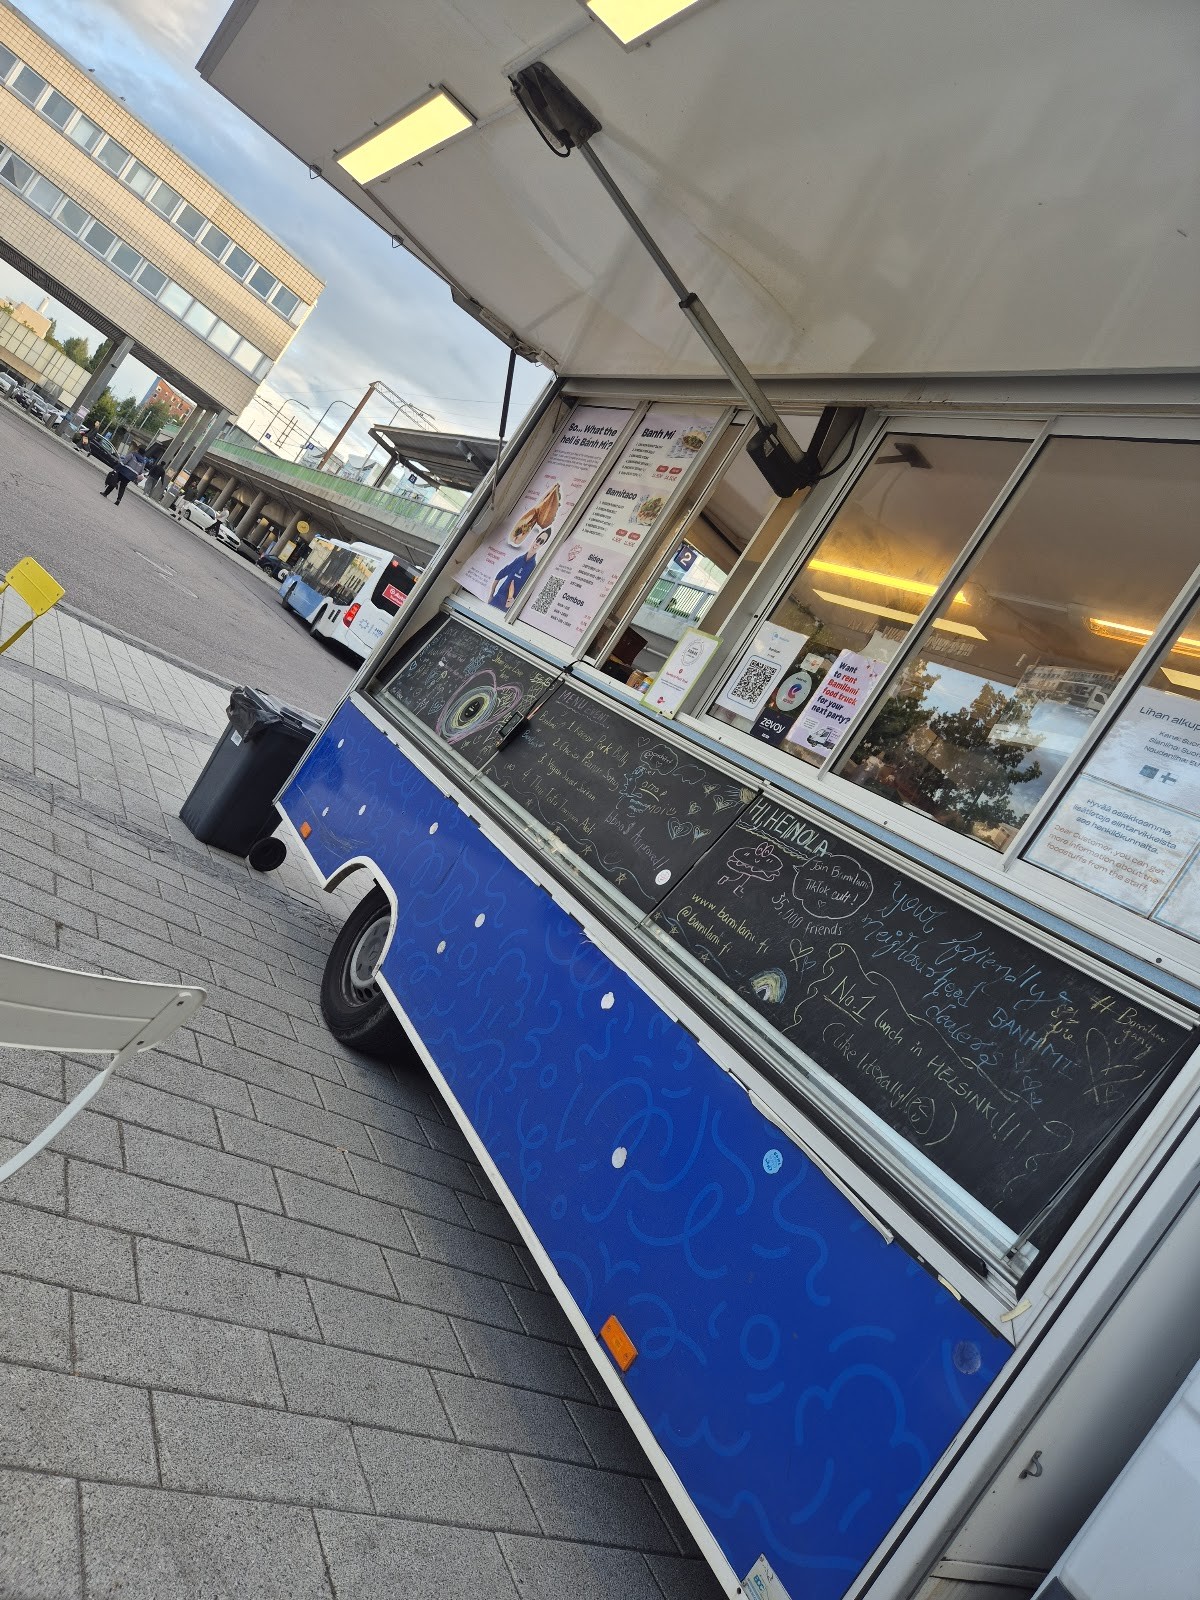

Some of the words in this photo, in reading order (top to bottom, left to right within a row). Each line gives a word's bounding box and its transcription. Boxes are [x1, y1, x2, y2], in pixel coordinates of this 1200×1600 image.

[560, 435, 574, 444] hell
[573, 436, 580, 445] is
[584, 425, 604, 435] What
[604, 427, 618, 437] the
[606, 487, 637, 500] Bamitaco
[587, 553, 604, 564] Sides
[680, 552, 692, 567] 2
[562, 593, 585, 607] Combos
[839, 661, 858, 674] Want
[827, 678, 860, 695] Bamilami
[833, 671, 842, 679] to
[842, 674, 858, 684] rent
[558, 689, 588, 710] MENU
[817, 695, 828, 704] for
[828, 700, 845, 711] your
[822, 687, 838, 698] food
[838, 692, 858, 706] truck
[811, 704, 827, 715] next
[826, 710, 851, 724] party?
[1140, 706, 1170, 721] Lihan
[760, 717, 785, 734] zevoy
[594, 735, 613, 755] Pork
[1087, 799, 1112, 813] Hyvää
[1111, 807, 1173, 838] asiakkaamme,
[763, 807, 828, 857] HEINOLA
[1111, 820, 1177, 850] elintarvikkeista
[810, 860, 828, 873] Join
[1046, 842, 1088, 864] foodstuffs
[1087, 859, 1108, 873] from
[1108, 868, 1124, 880] the
[1049, 833, 1070, 845] more
[1068, 840, 1115, 866] information
[1115, 861, 1143, 879] about
[1143, 874, 1160, 885] the
[1113, 850, 1131, 862] you
[1131, 858, 1148, 869] can
[1148, 865, 1166, 876] get
[805, 878, 831, 895] TikTok
[677, 906, 733, 956] @bamilami.fi
[691, 893, 769, 954] www.bamilami.fi
[805, 922, 843, 936] friends
[935, 932, 1060, 1011] friendly
[830, 976, 876, 1020] No.1
[874, 1009, 903, 1045] lunch
[911, 1040, 923, 1056] in
[926, 1004, 998, 1071] dealers
